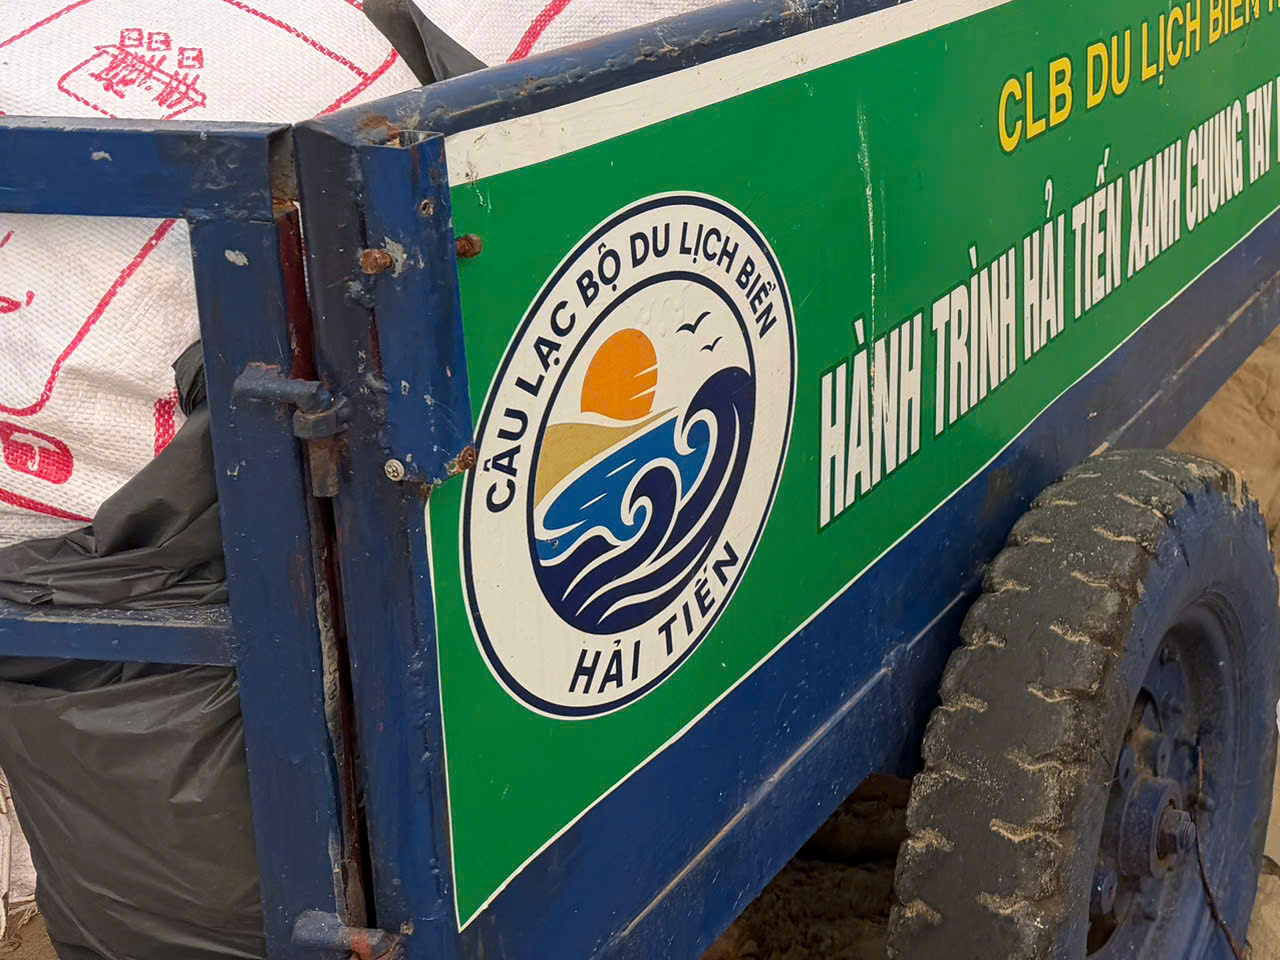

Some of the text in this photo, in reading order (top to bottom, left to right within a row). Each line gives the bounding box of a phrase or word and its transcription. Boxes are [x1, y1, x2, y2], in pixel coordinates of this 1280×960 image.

[998, 56, 1075, 154] CLB
[1087, 32, 1131, 109] DU
[1140, 2, 1202, 87] LỊCH
[483, 221, 778, 513] CÂU LẠC BỘ DU LỊCH BIỂN
[818, 317, 924, 531] HÀNH
[932, 242, 1017, 439] TRÌNH
[1023, 177, 1067, 362] HẢI
[1072, 146, 1124, 321] TIẾN
[1127, 138, 1183, 280] XANH
[1184, 97, 1245, 232] CHUNG
[1246, 80, 1273, 187] TAY
[569, 539, 741, 695] HẢI TIẾN
